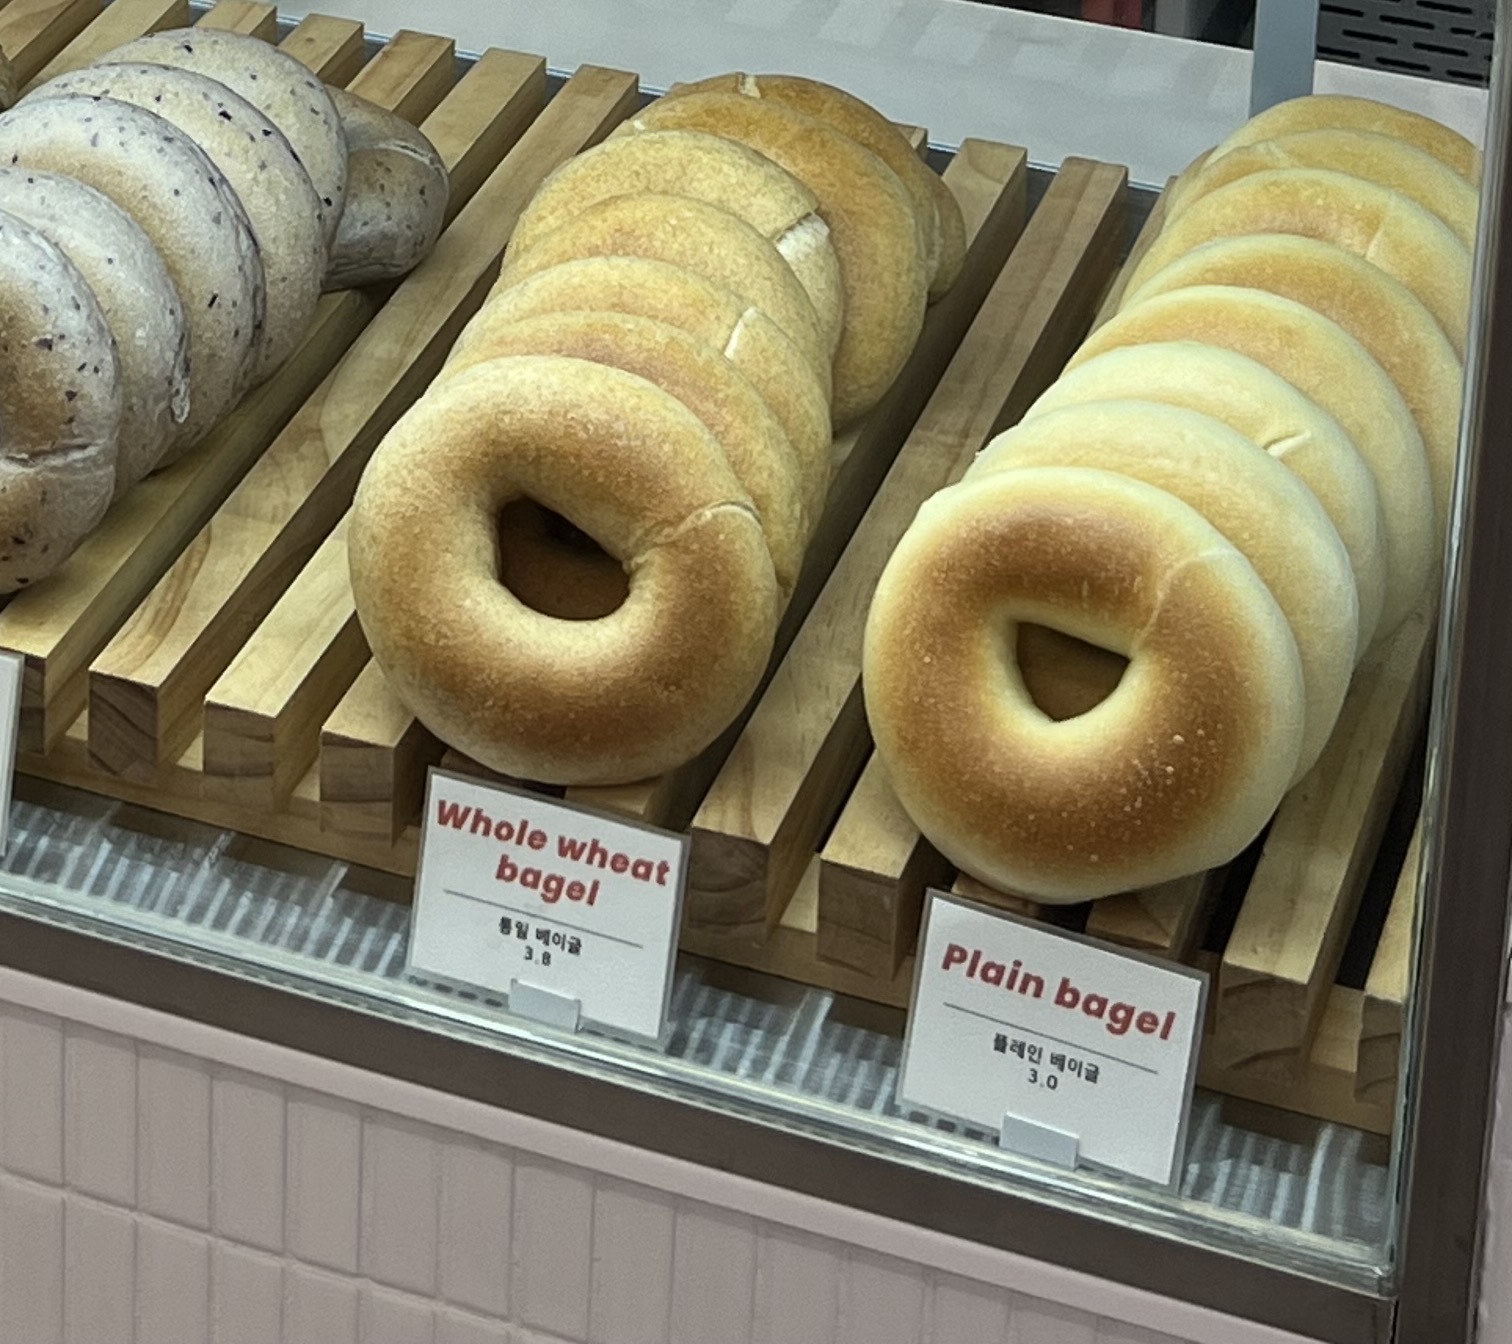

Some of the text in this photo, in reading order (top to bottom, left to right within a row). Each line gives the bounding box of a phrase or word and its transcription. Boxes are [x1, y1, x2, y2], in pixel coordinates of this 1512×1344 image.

[437, 799, 671, 886] Whole wheat
[495, 854, 600, 906] bagel
[499, 916, 583, 957] 통밀 베이글
[524, 946, 552, 967] 3.8
[941, 943, 1176, 1041] Plain bagel
[993, 1032, 1101, 1084] 플레인 베이글
[1028, 1068, 1058, 1091] 3.0
